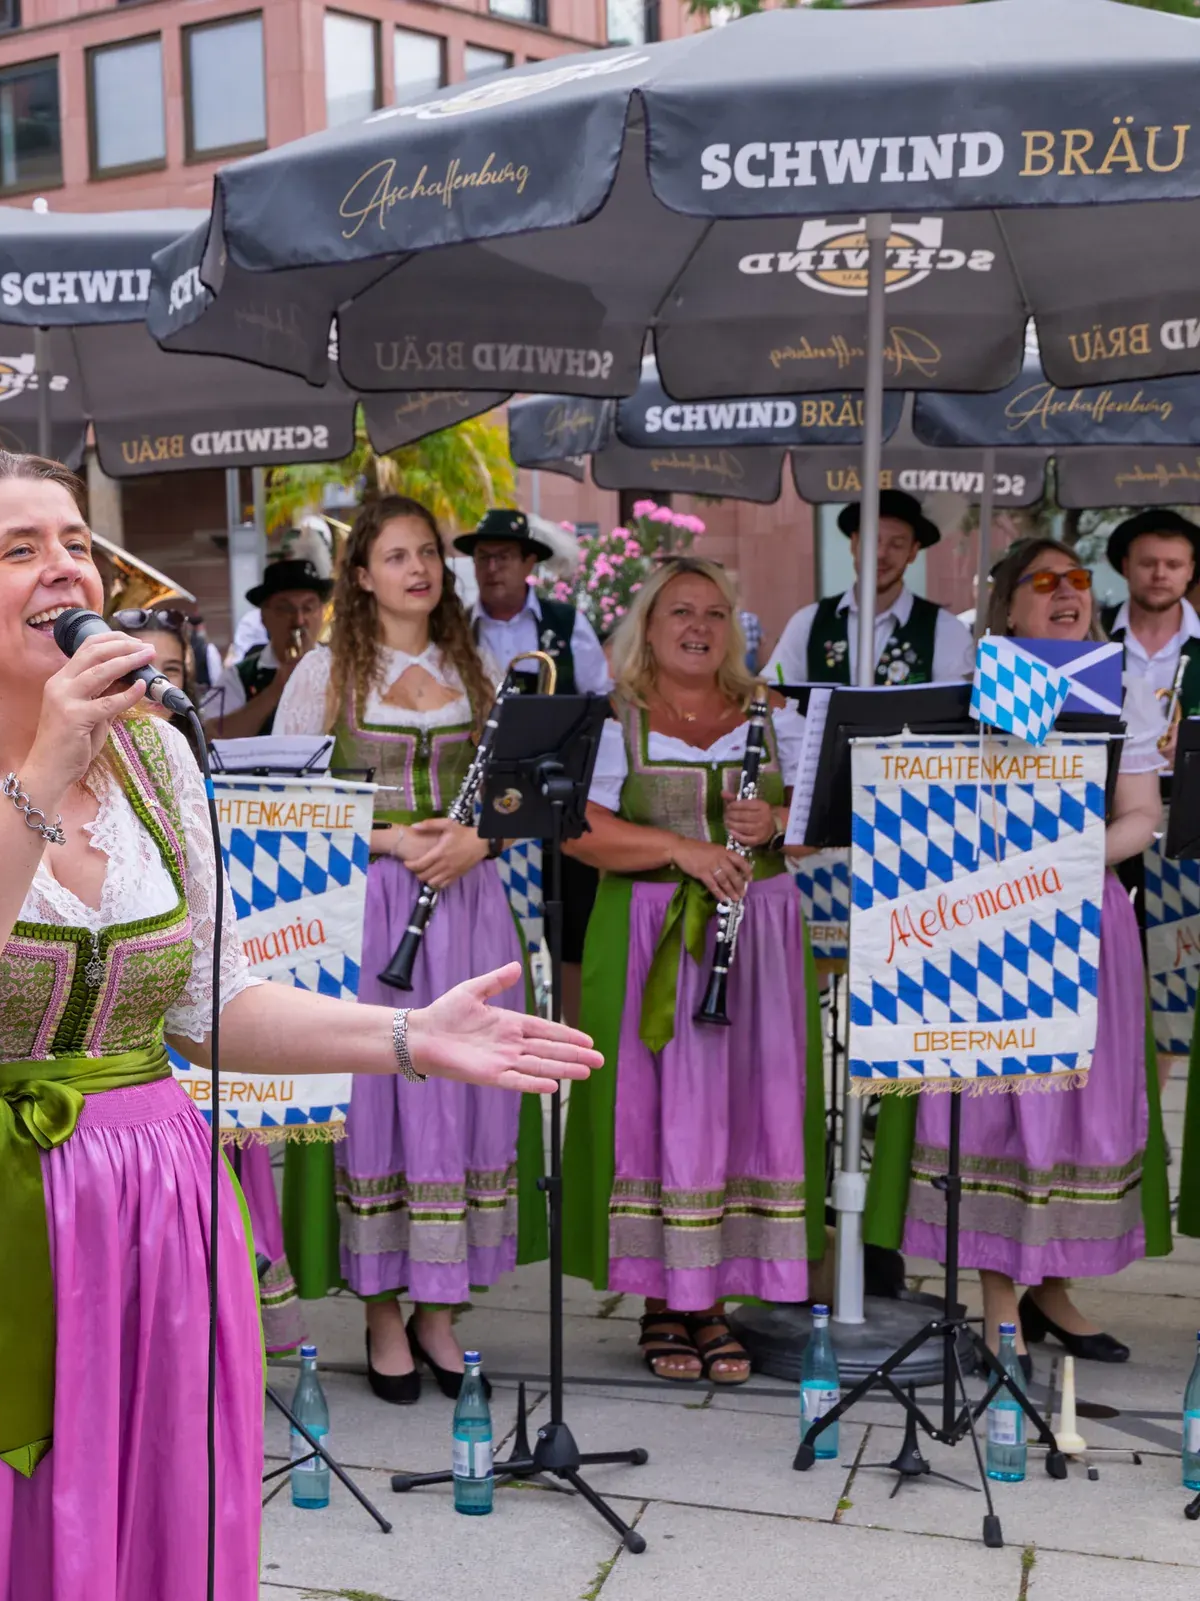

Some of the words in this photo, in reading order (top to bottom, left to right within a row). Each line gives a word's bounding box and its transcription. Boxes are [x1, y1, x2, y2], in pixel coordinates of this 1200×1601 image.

[701, 131, 1004, 190] SCHWIND
[1018, 116, 1191, 177] BRÄU
[339, 152, 530, 239] Aschaffenburg
[644, 400, 797, 433] SCHWIND
[1004, 381, 1174, 431] Aschaffenburg
[881, 754, 1084, 780] TRACHTENKAPELLE
[216, 799, 356, 829] HTENKAPELLE
[885, 865, 1064, 965] Melomania
[242, 915, 327, 968] mania
[914, 1028, 1036, 1052] OBERNAU
